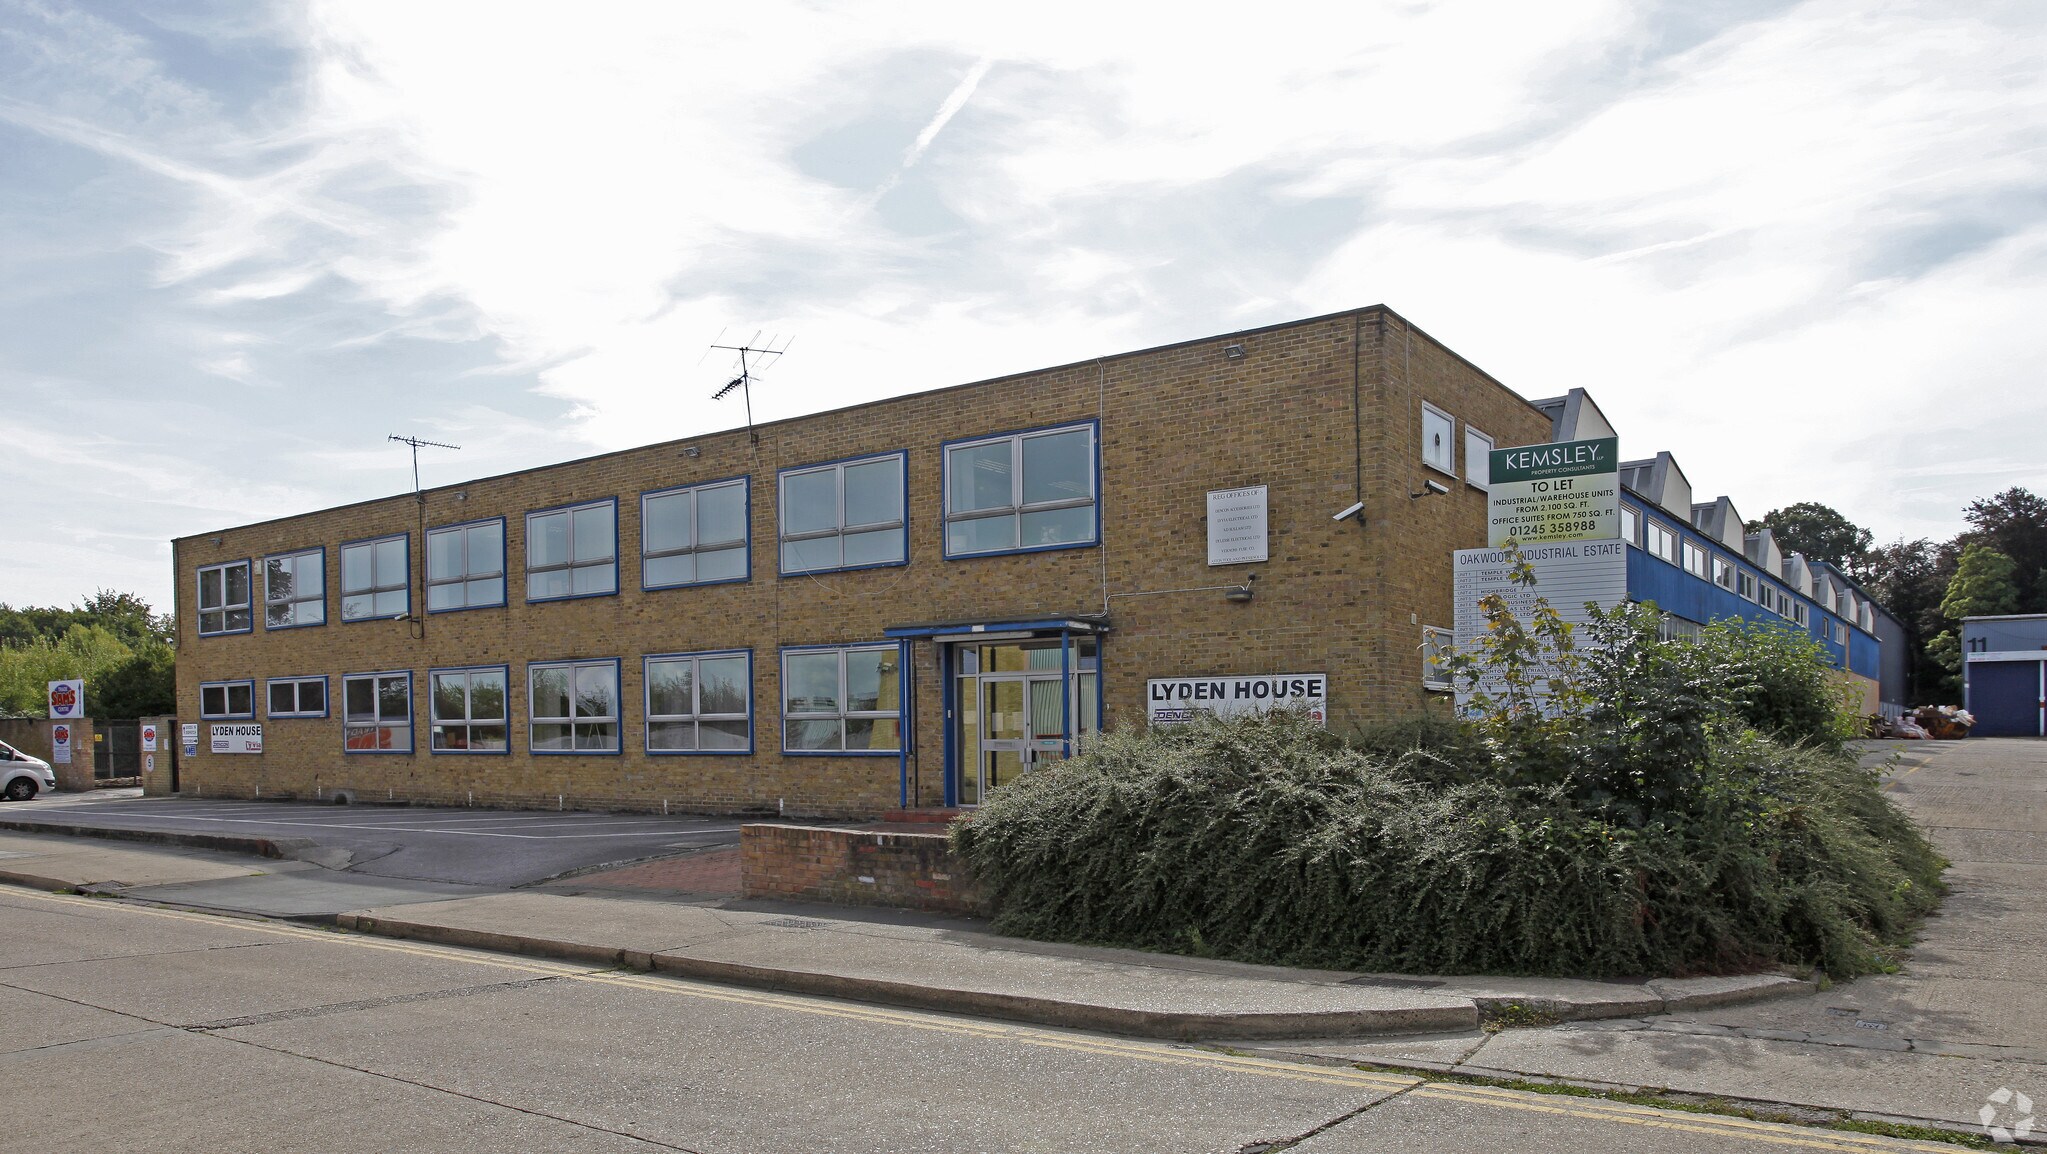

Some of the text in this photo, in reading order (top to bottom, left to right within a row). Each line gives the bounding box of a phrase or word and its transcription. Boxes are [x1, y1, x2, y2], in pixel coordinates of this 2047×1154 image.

[1506, 444, 1600, 470] KEMSLEY
[1531, 464, 1596, 476] PROPERTY CONSULTANTS
[1532, 479, 1574, 492] TO LET
[1226, 490, 1250, 499] OFFICES
[1494, 490, 1614, 506] INDUSTRIAL/WAREHOUSE UNITS
[1516, 506, 1538, 514] FROM
[1492, 518, 1519, 526] OFFICE
[1522, 514, 1544, 522] SUITES
[1547, 512, 1570, 520] FROM
[1510, 520, 1596, 536] 01245 358988
[1522, 532, 1583, 542] www.kemsley.com
[1460, 552, 1510, 565] OAKWOO
[1584, 544, 1621, 558] ESTATE
[1968, 637, 1986, 652] 11
[1152, 680, 1322, 700] LYDEN HOUSE
[213, 726, 260, 736] LYDEN HOUSE
[148, 759, 152, 767] 5
